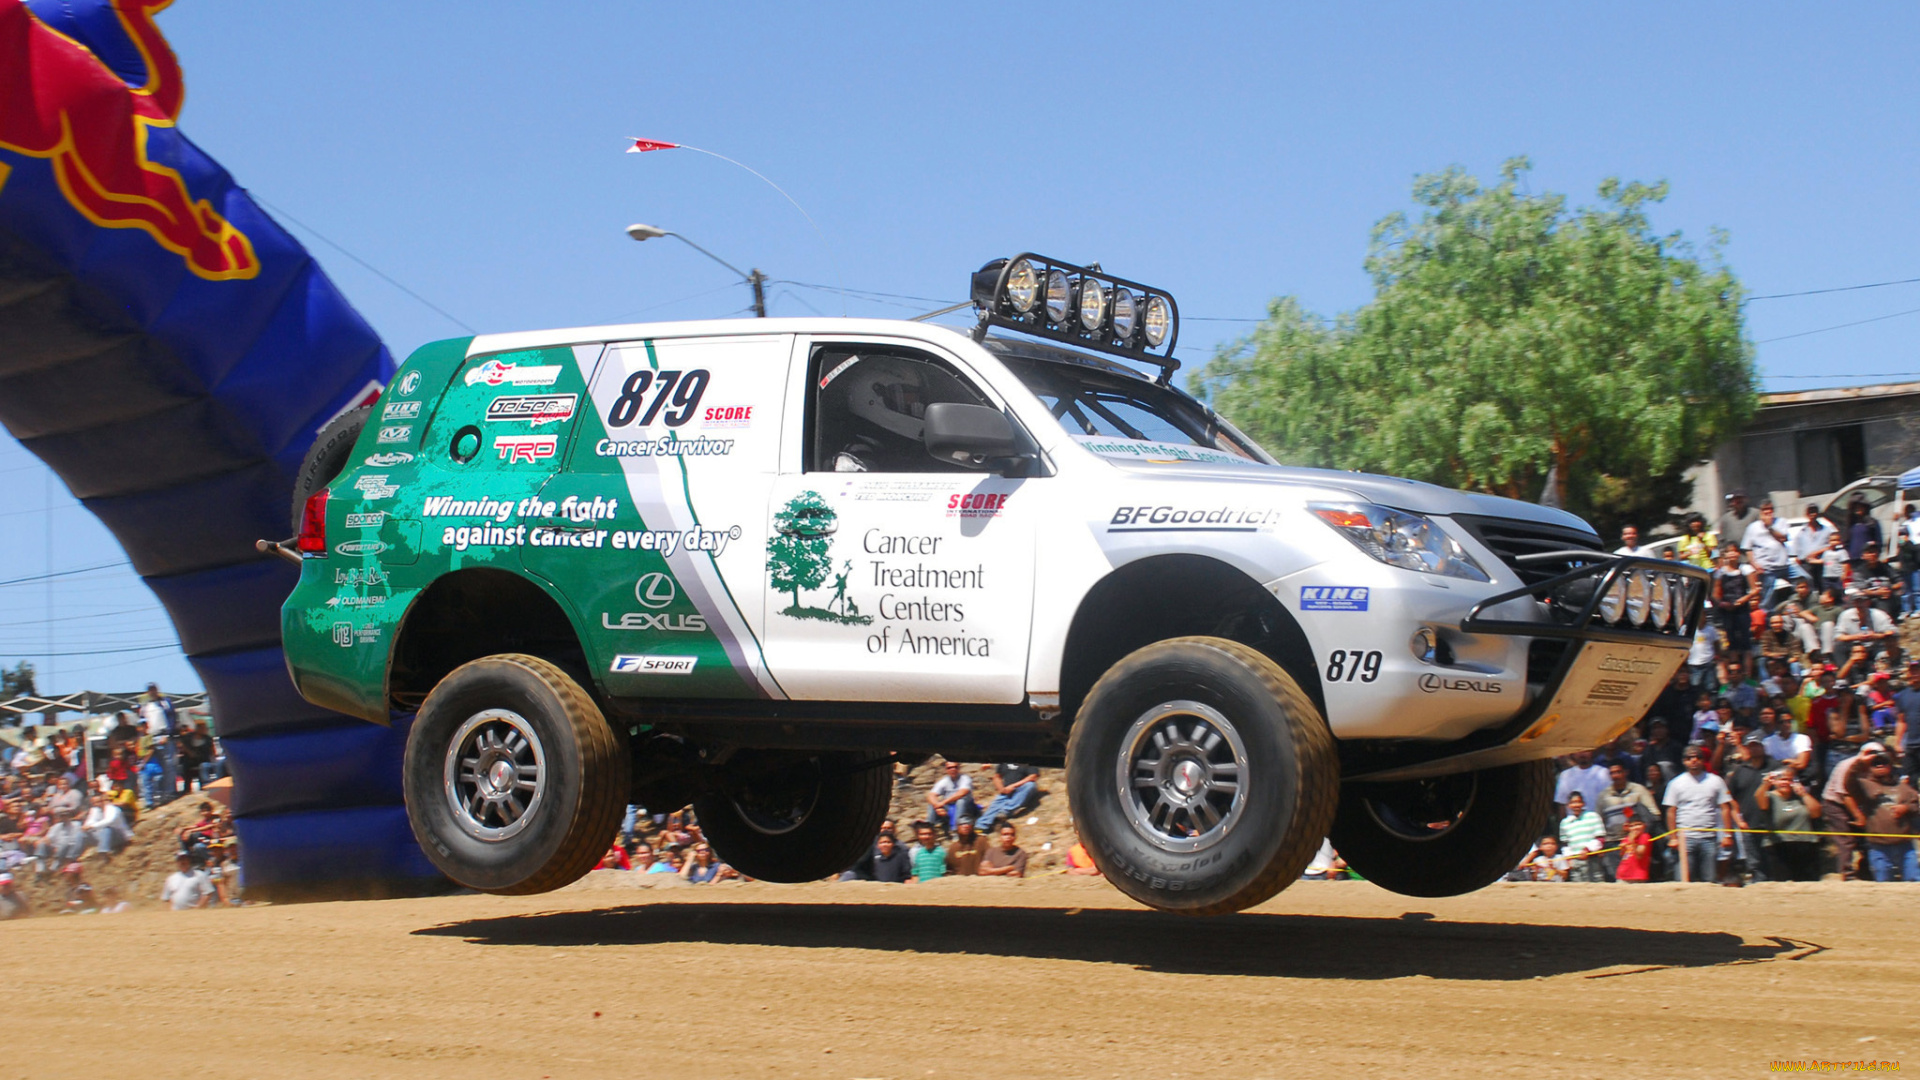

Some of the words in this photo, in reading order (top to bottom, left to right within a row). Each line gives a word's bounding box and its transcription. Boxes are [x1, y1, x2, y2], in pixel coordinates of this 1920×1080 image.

[400, 372, 420, 395] KC
[384, 402, 420, 413] KING
[608, 369, 710, 427] 879
[705, 406, 753, 420] SCORE
[496, 442, 555, 462] TRD
[595, 438, 656, 456] Cancer
[656, 435, 735, 456] Survivor
[1138, 443, 1161, 455] the
[1160, 445, 1193, 460] fight
[422, 496, 515, 521] Winning
[517, 496, 557, 518] the
[560, 496, 618, 522] fight
[948, 494, 1008, 509] SCORE
[1110, 506, 1281, 525] BFGoodrich
[442, 521, 527, 551] against
[529, 527, 607, 549] cancer
[611, 529, 680, 558] every
[863, 528, 942, 555] Cancer
[870, 561, 985, 589] Treatment
[1302, 587, 1368, 599] KING
[879, 593, 964, 622] Centers
[602, 612, 707, 632] LEXUS
[867, 626, 891, 654] of
[898, 628, 990, 656] America
[643, 660, 692, 670] SPORT
[1326, 650, 1383, 682] 879
[1444, 679, 1502, 693] LEXUS
